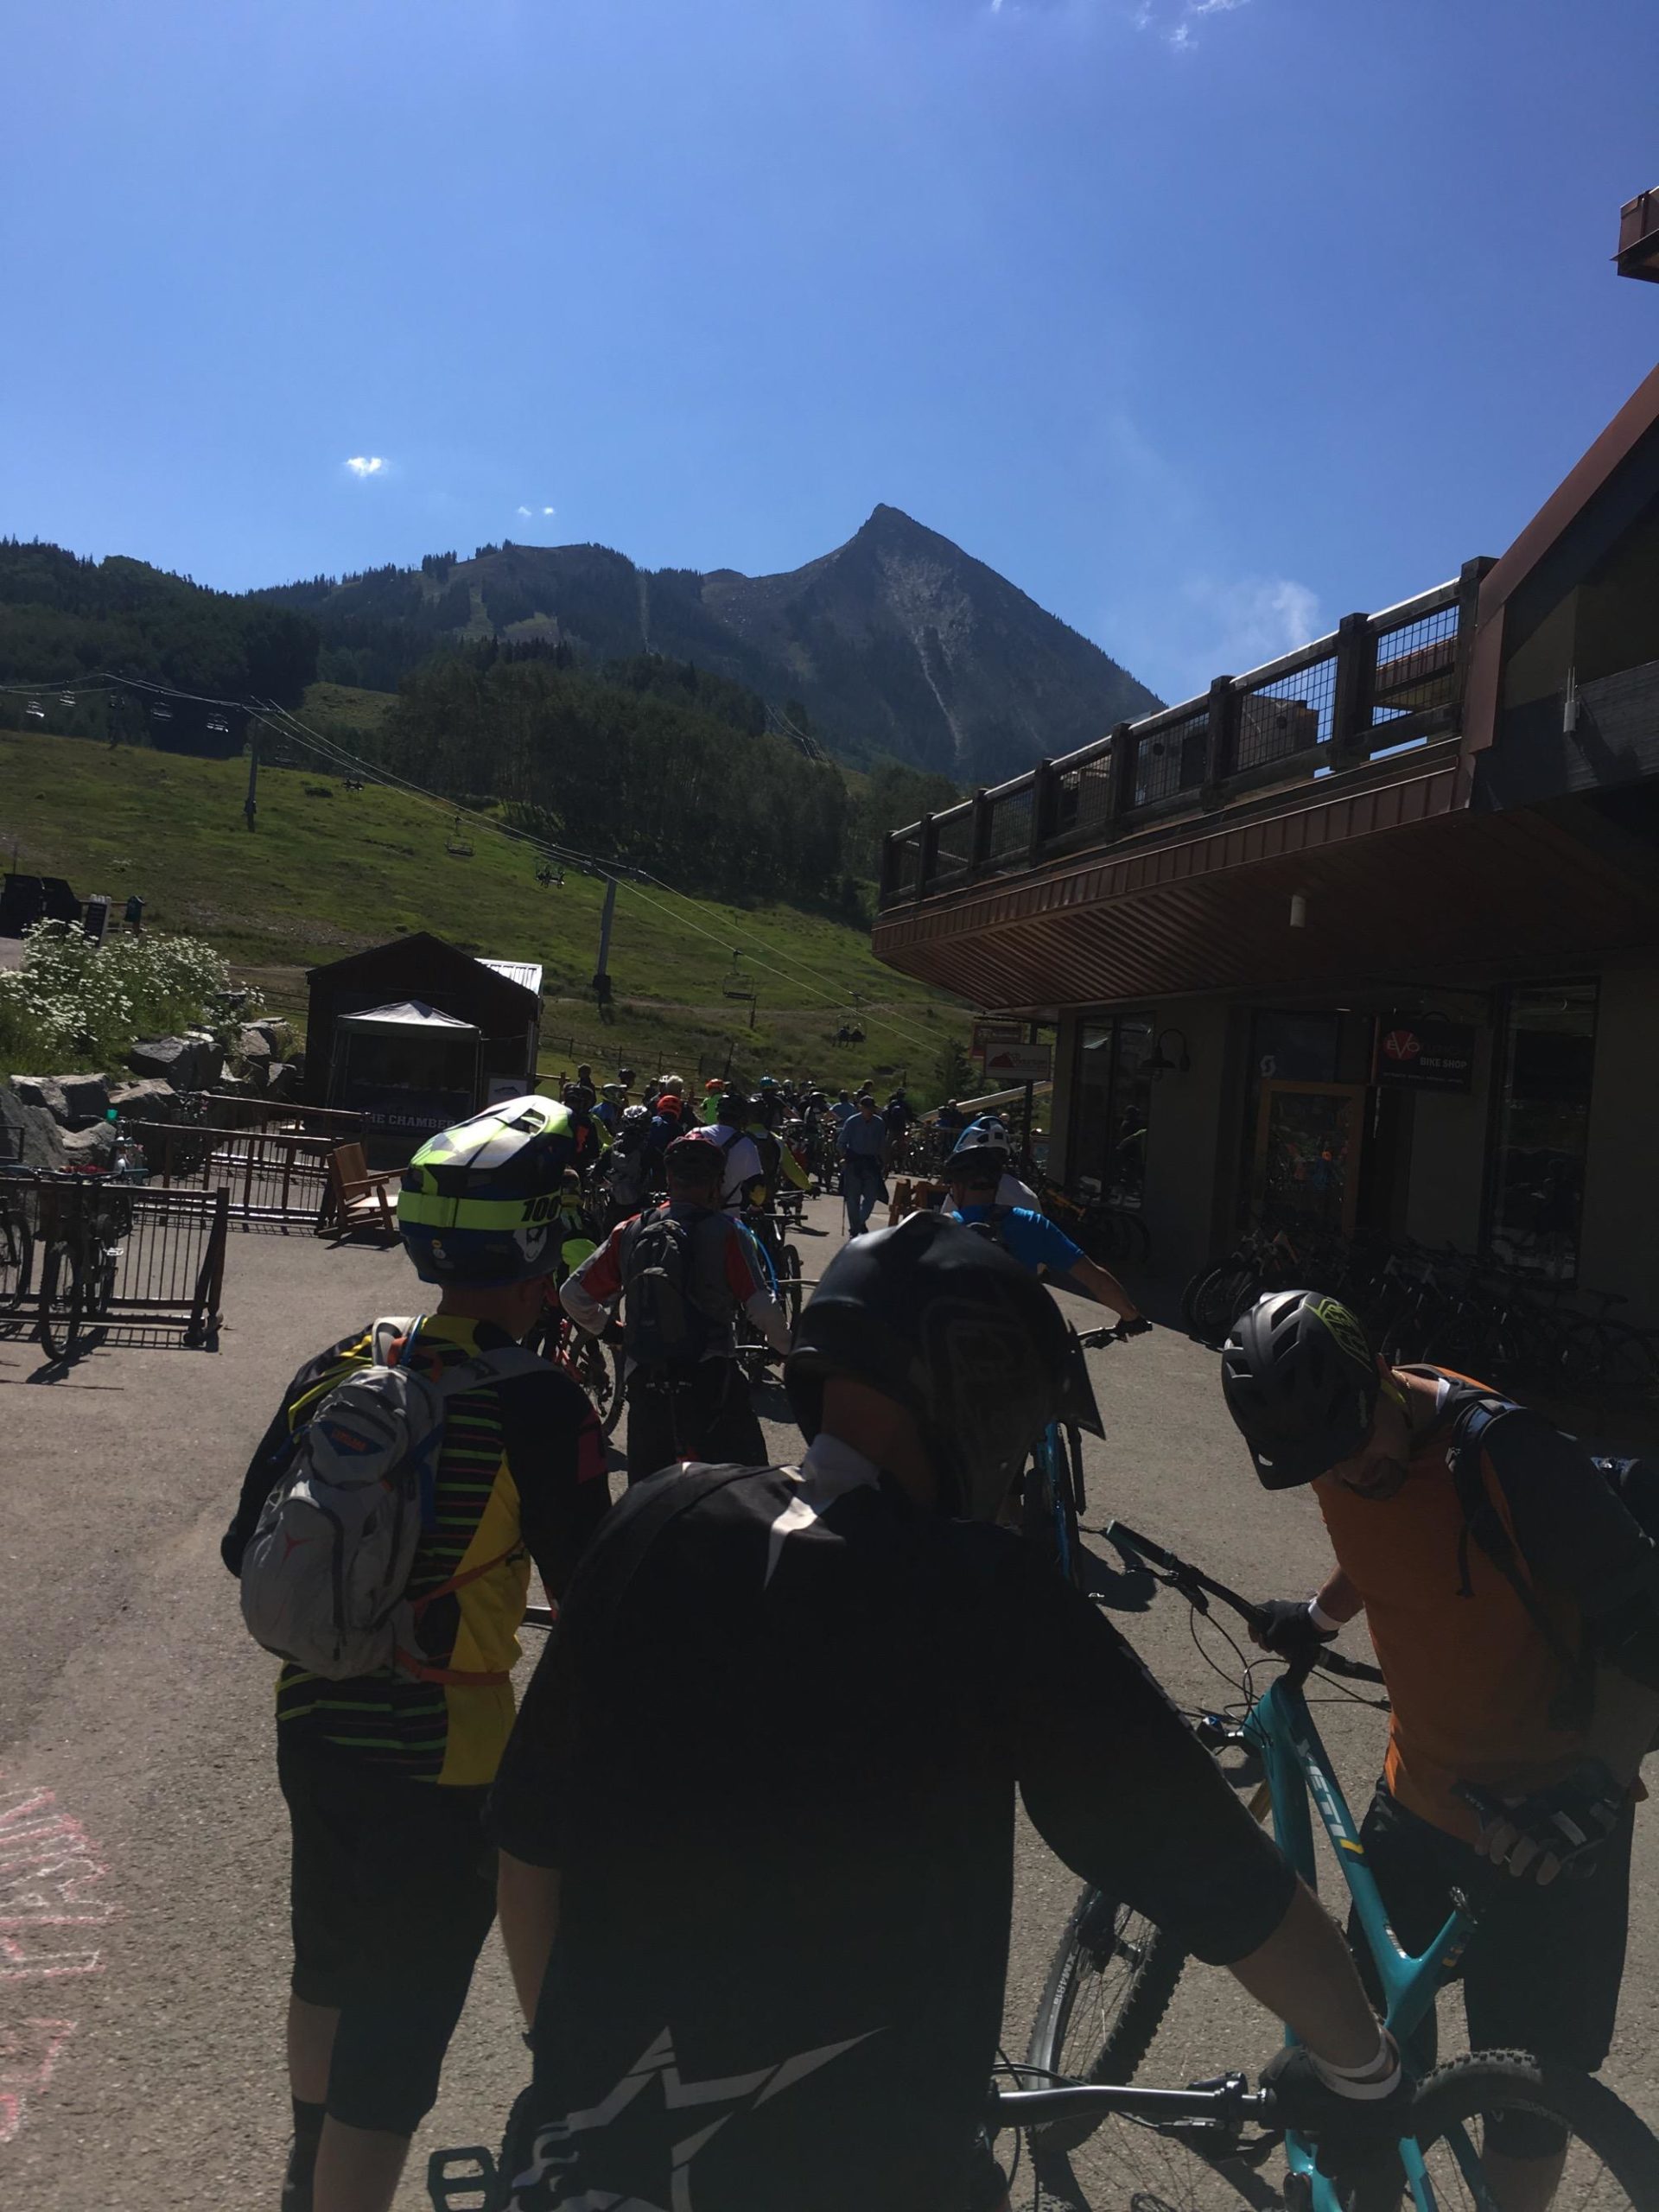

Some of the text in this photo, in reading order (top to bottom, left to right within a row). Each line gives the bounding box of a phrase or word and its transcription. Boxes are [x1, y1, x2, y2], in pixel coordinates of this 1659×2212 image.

[1420, 1057, 1468, 1070] BIKE SHOP
[1296, 1738, 1348, 1838] YETI
